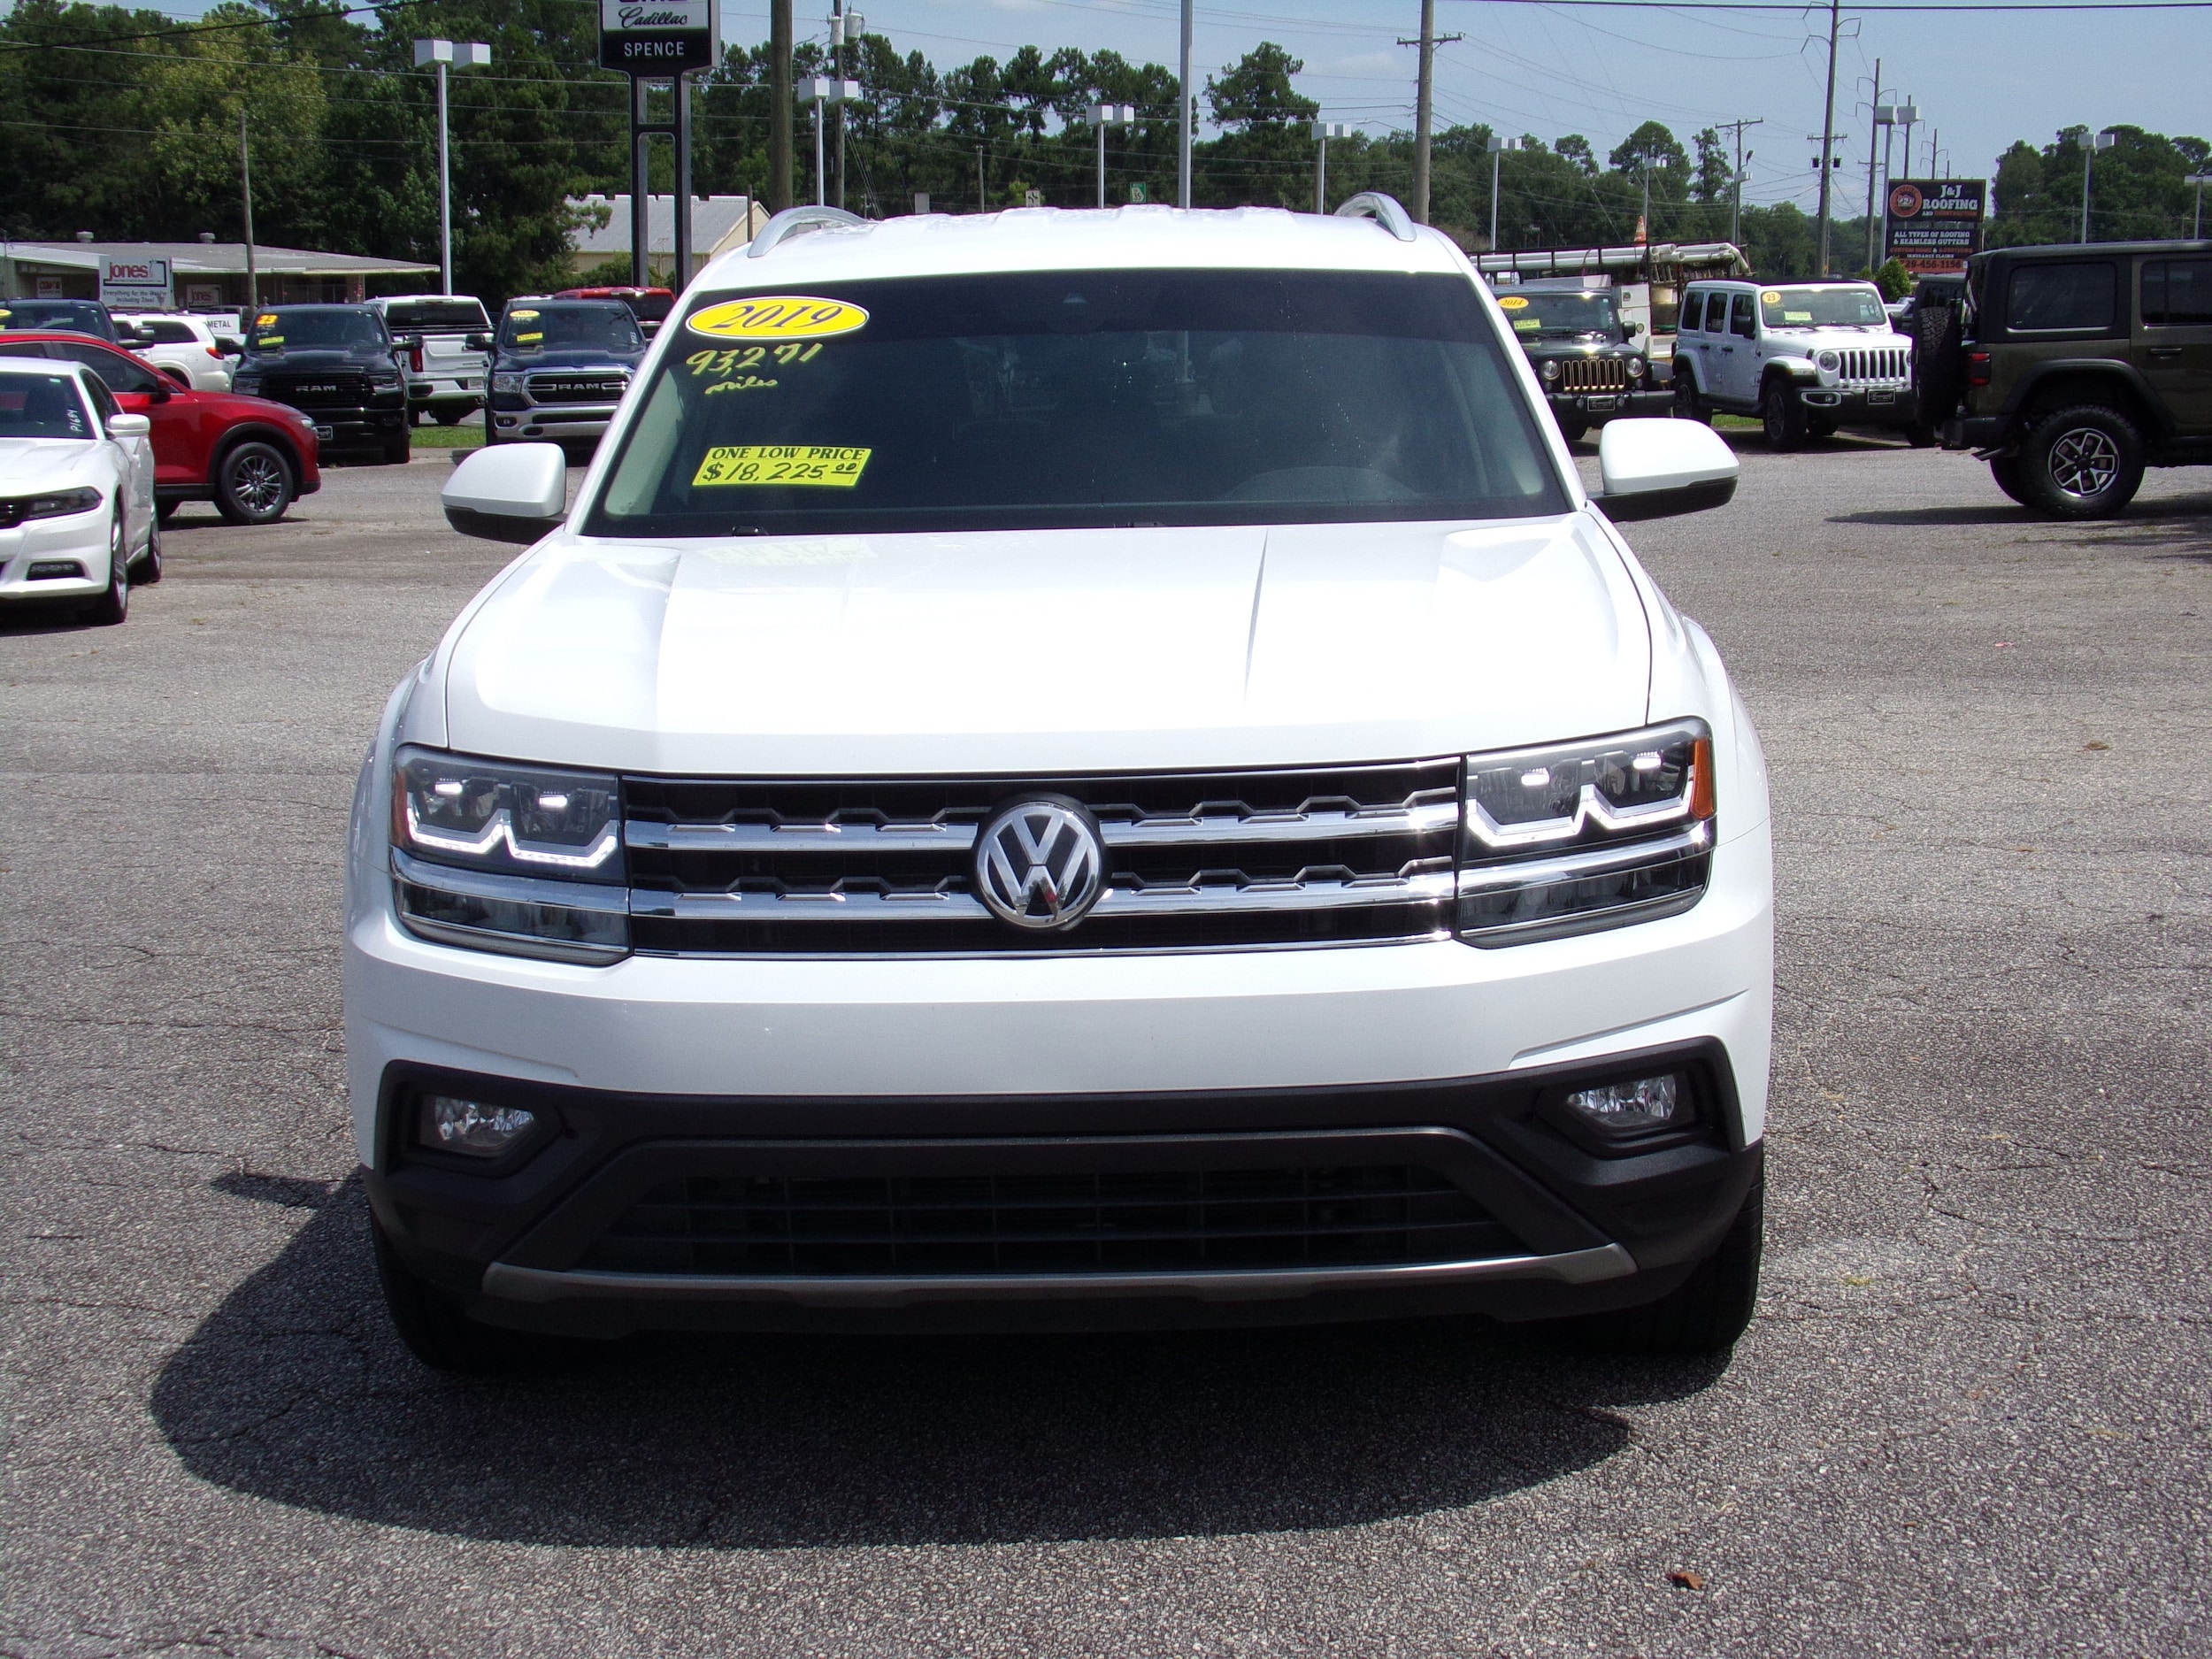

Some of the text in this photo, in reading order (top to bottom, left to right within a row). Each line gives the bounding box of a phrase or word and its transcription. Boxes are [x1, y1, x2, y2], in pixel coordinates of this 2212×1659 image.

[618, 6, 687, 28] Cadillac
[624, 42, 685, 57] SPENCE
[1940, 185, 1962, 198] J&J
[1922, 199, 1978, 210] ROOFING
[109, 262, 149, 281] jones
[1766, 293, 1776, 302] 23
[257, 314, 278, 325] 23
[707, 304, 843, 329] 2019
[711, 448, 865, 460] ONE LOW PRICE
